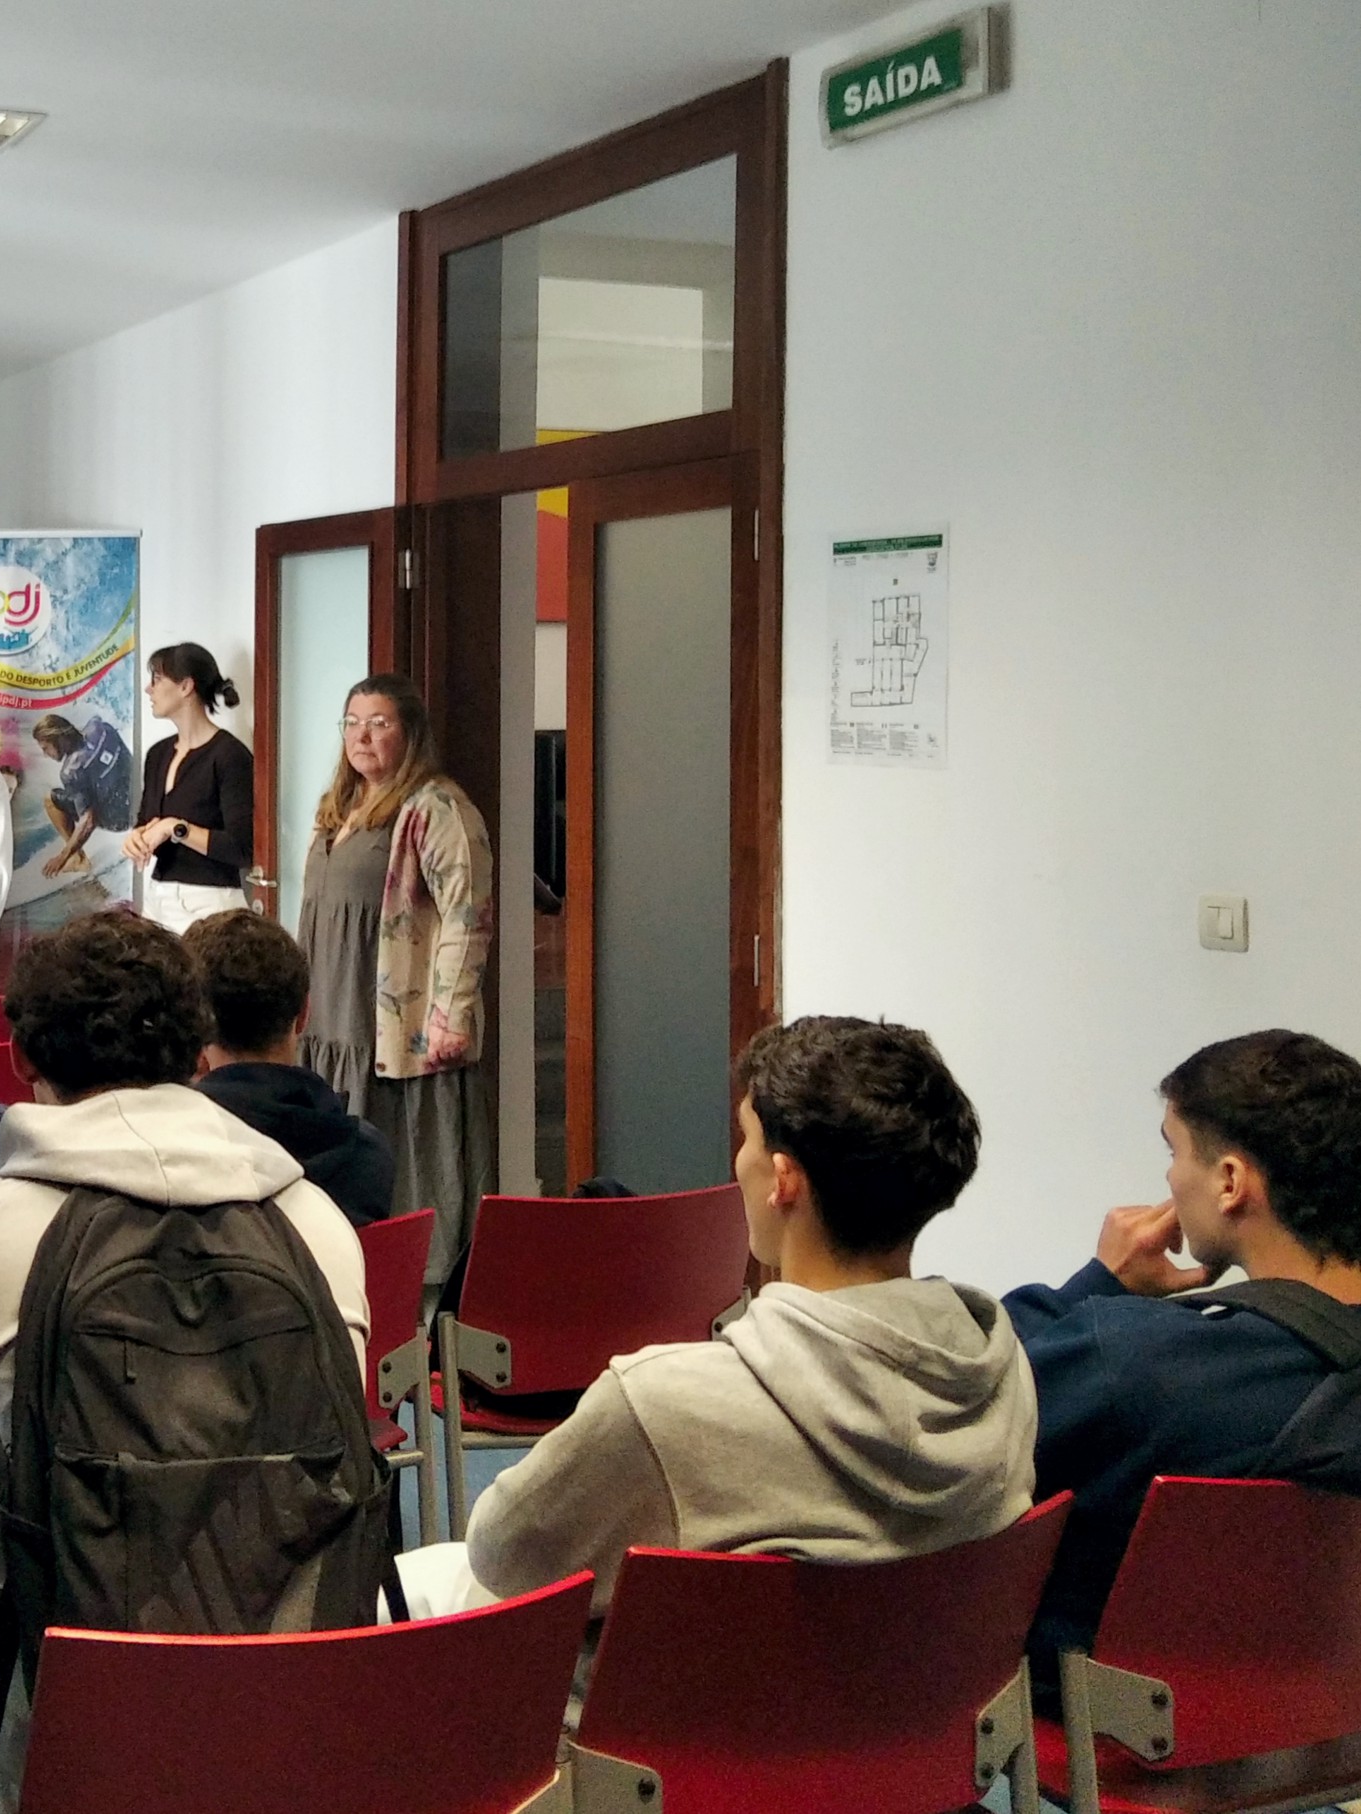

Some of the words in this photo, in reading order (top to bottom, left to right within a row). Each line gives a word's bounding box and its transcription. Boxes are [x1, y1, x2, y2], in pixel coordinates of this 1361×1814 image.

[843, 55, 942, 116] SAÍDA
[0, 670, 14, 681] DO
[15, 675, 64, 688] DESPORTO
[66, 672, 72, 681] E
[74, 643, 120, 678] JUVENTUDE
